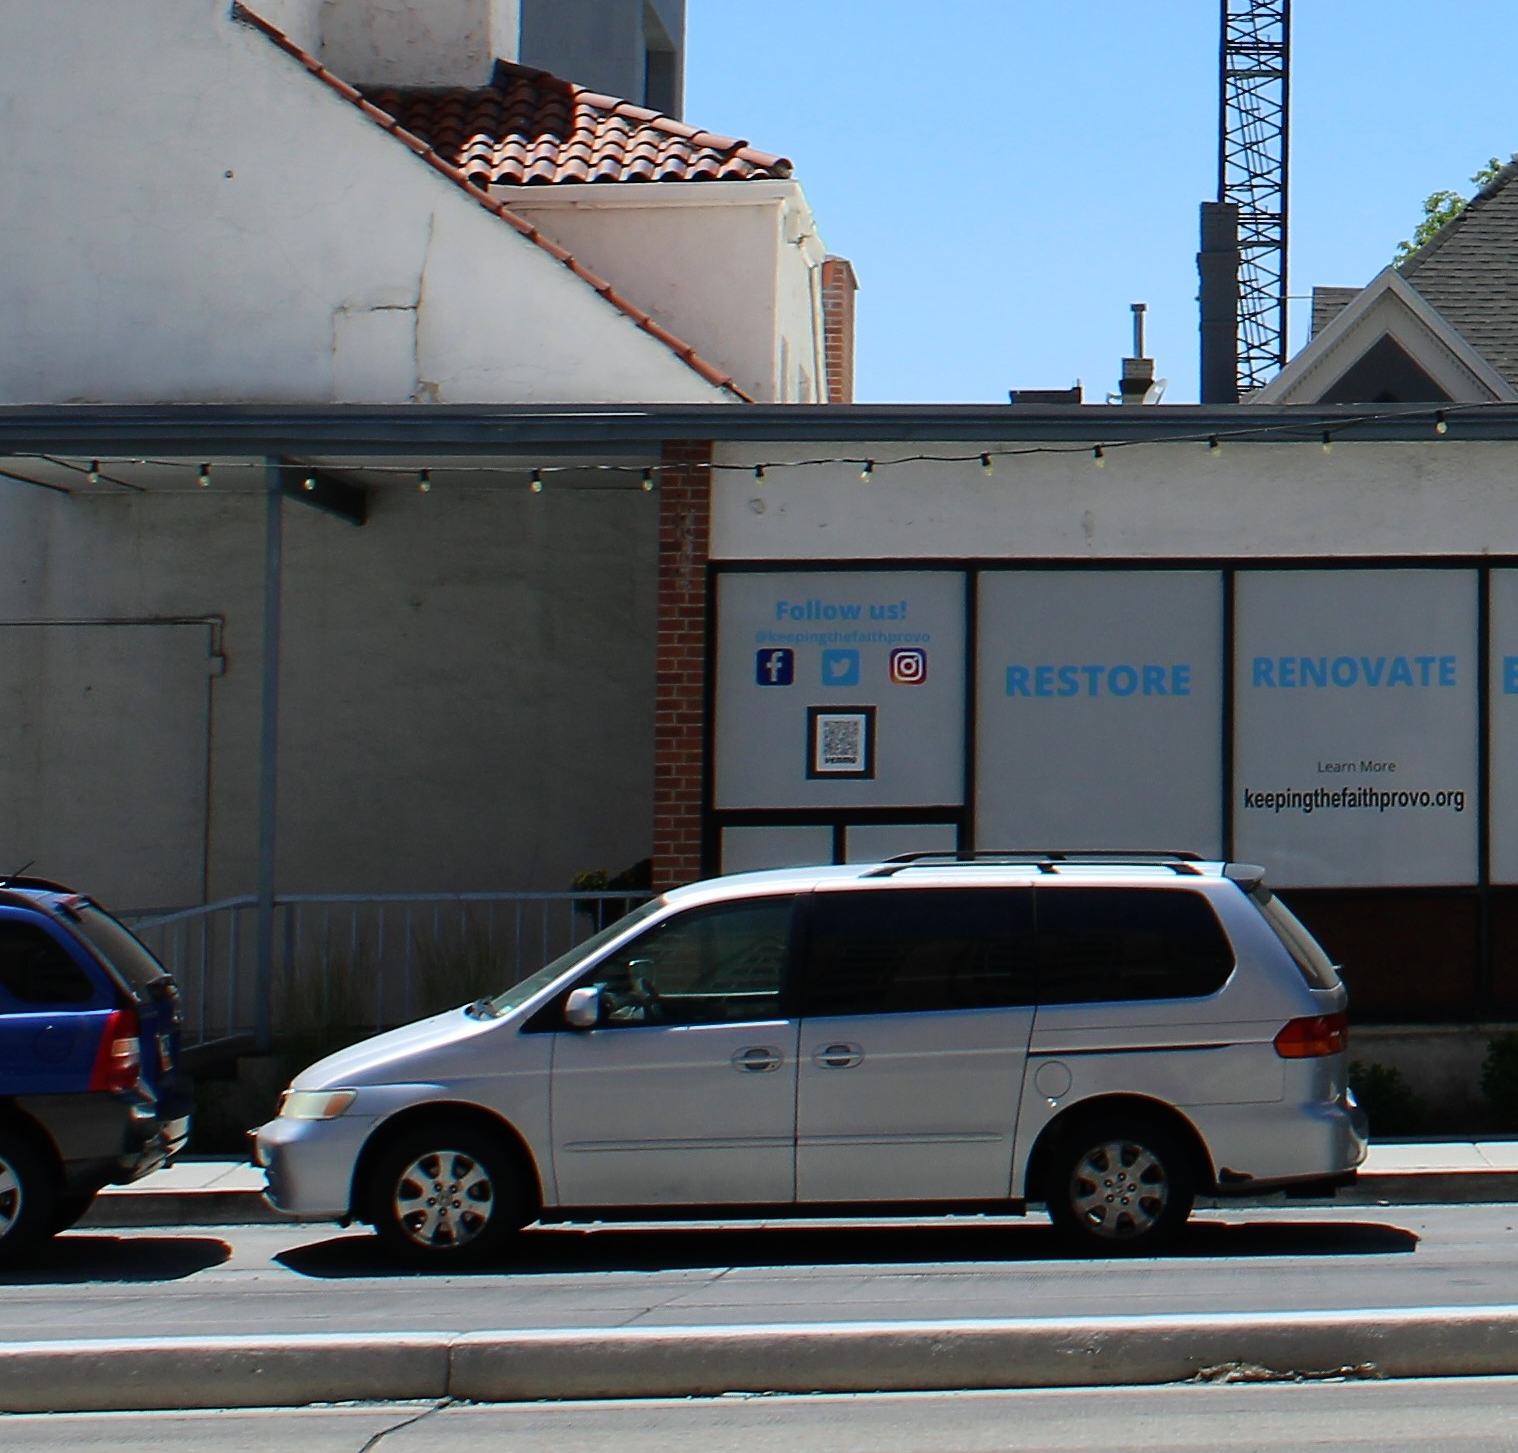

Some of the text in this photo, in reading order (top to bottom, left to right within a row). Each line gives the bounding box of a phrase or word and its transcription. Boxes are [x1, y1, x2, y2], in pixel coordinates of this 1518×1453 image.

[776, 601, 908, 620] Follow us!
[754, 629, 930, 645] @keepingthefaithprovo
[1006, 664, 1192, 696] RESTORE
[1252, 655, 1457, 688] RENOVATE
[1317, 760, 1396, 773] Learn More
[1244, 787, 1465, 813] keepingthefaithprovo.org
